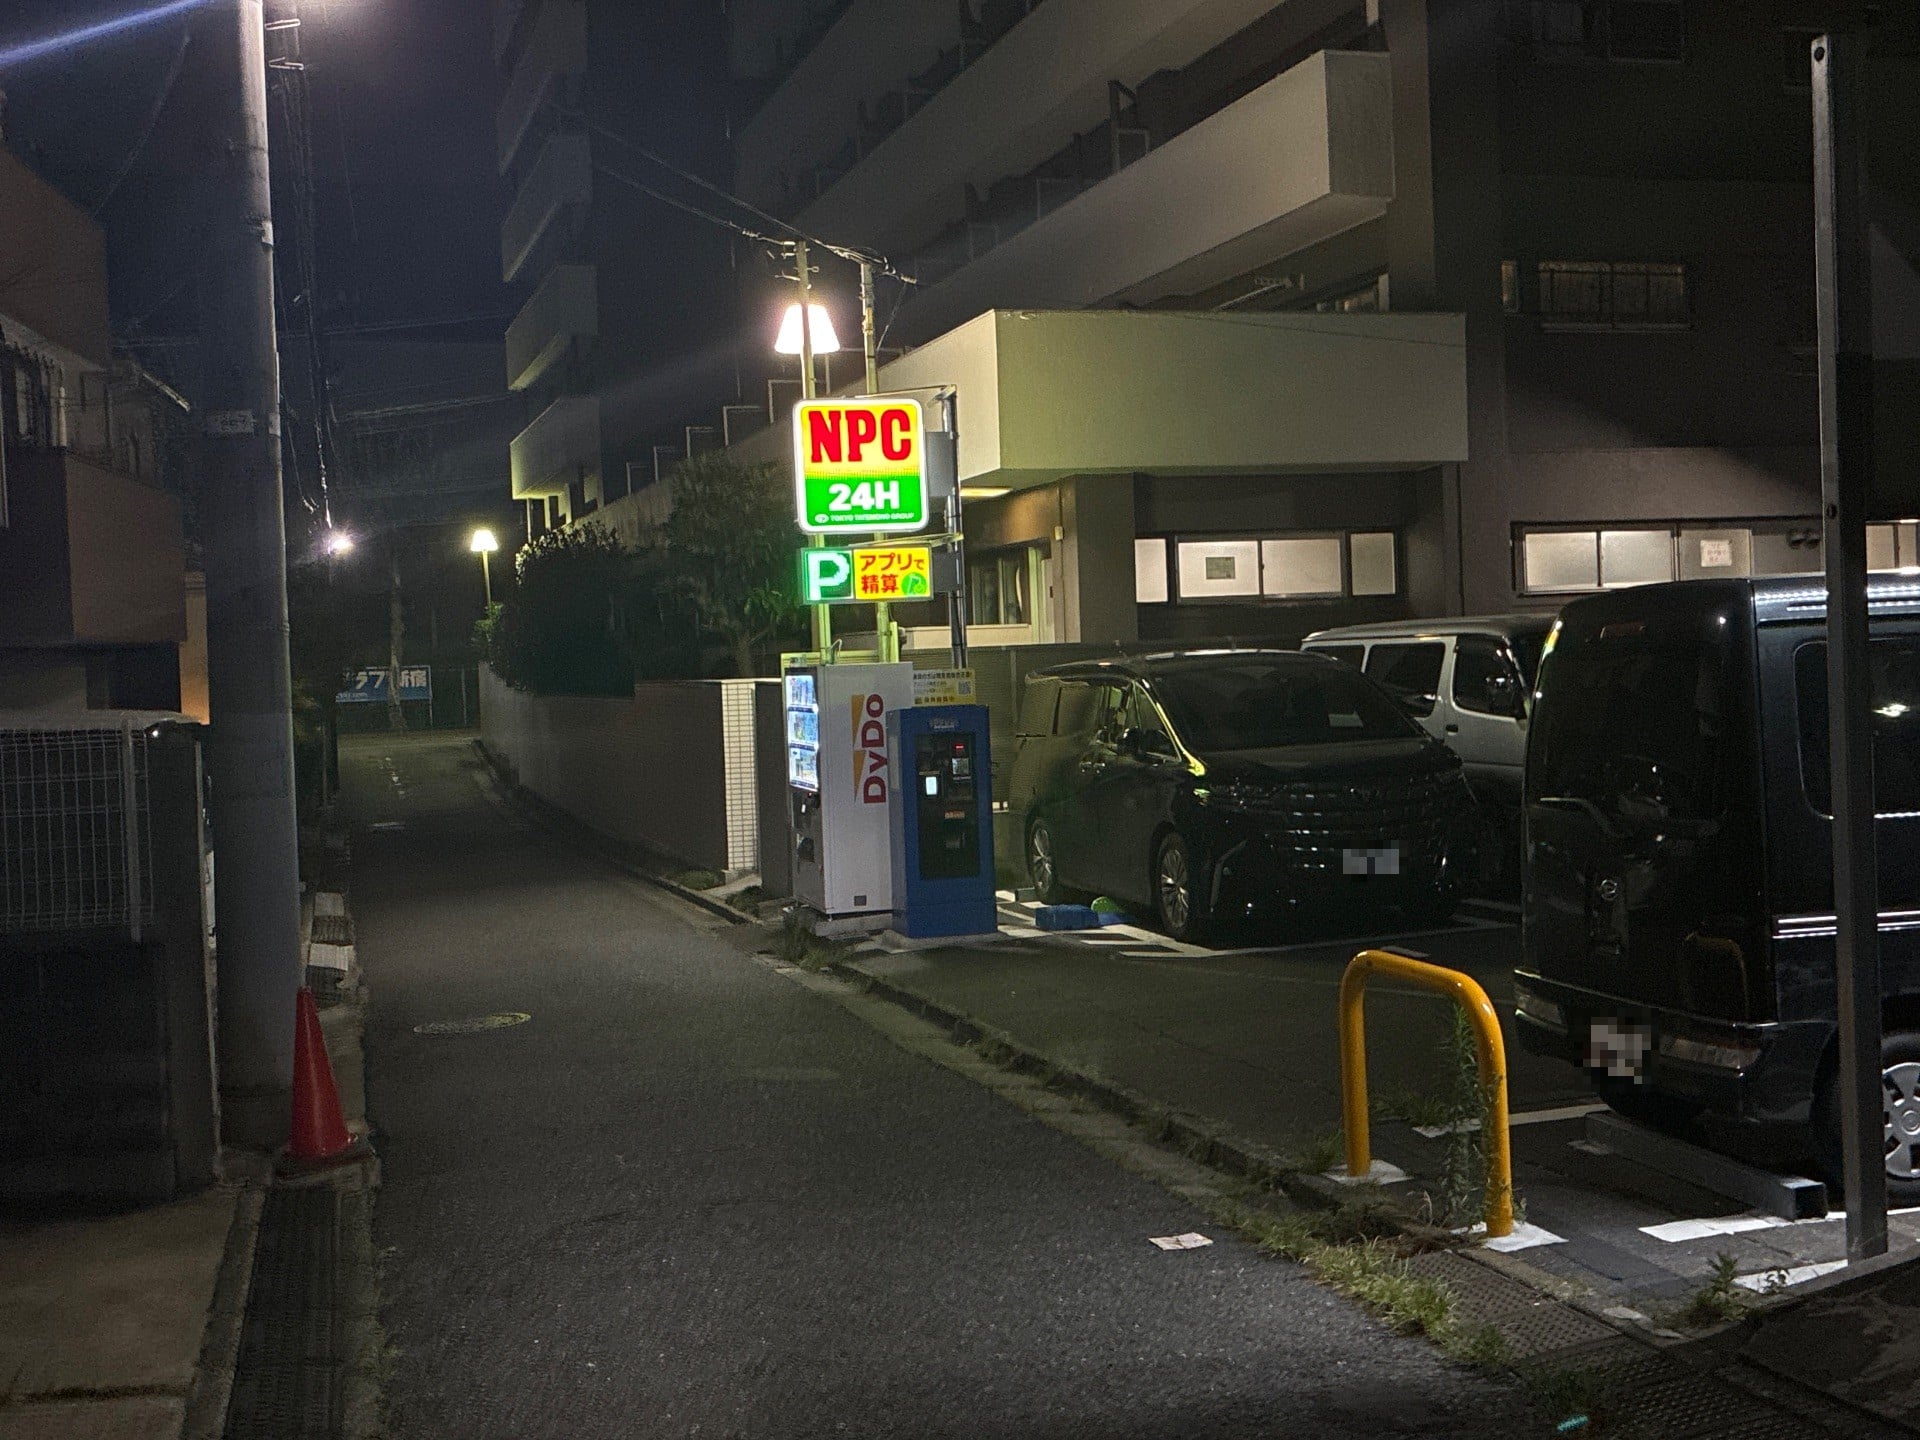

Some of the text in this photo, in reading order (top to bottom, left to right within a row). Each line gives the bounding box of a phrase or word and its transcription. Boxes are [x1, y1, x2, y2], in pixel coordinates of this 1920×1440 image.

[808, 409, 912, 463] NPC
[828, 480, 900, 511] 24H
[807, 552, 850, 601] P
[859, 553, 925, 572] アプリで
[861, 573, 900, 595] 精算
[861, 694, 888, 803] DyDo
